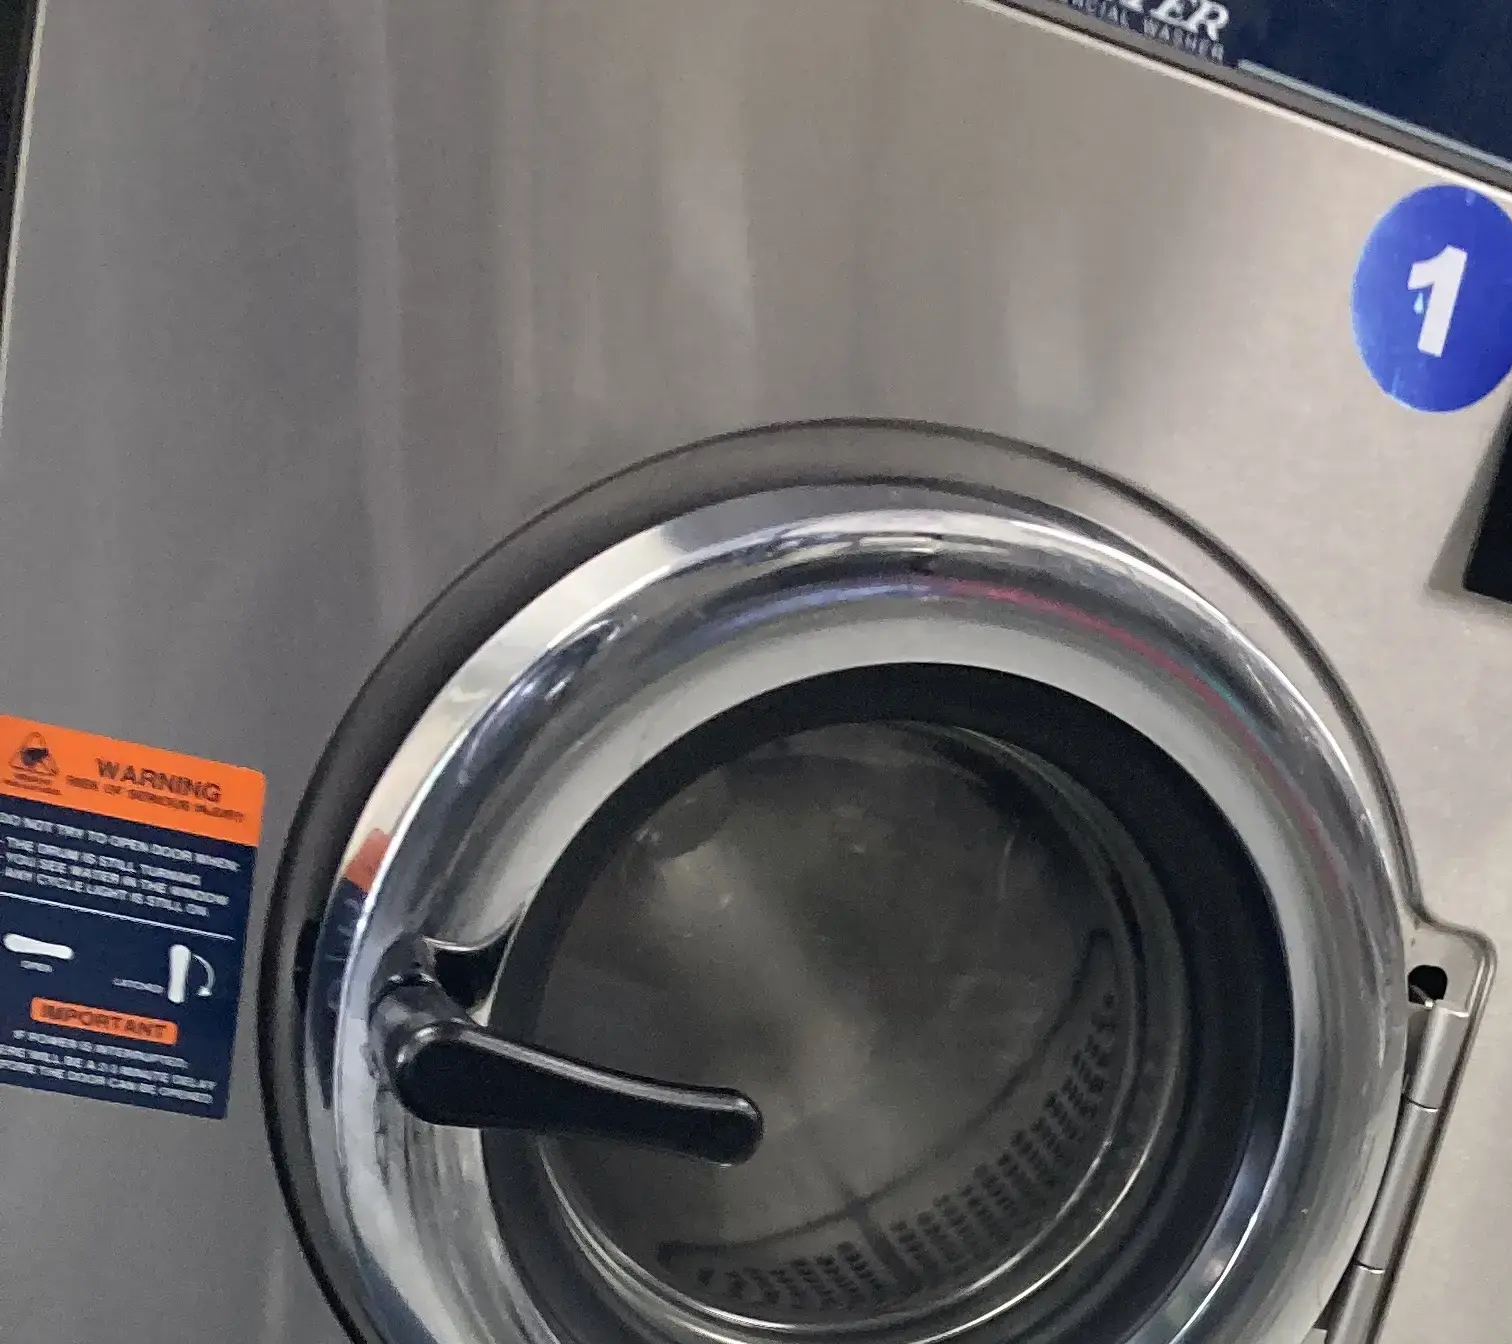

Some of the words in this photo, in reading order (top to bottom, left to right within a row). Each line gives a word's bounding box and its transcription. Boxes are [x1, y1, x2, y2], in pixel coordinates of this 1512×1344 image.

[1408, 244, 1468, 358] 1
[94, 757, 222, 803] WARNING
[40, 1003, 167, 1040] IMPORTANT
